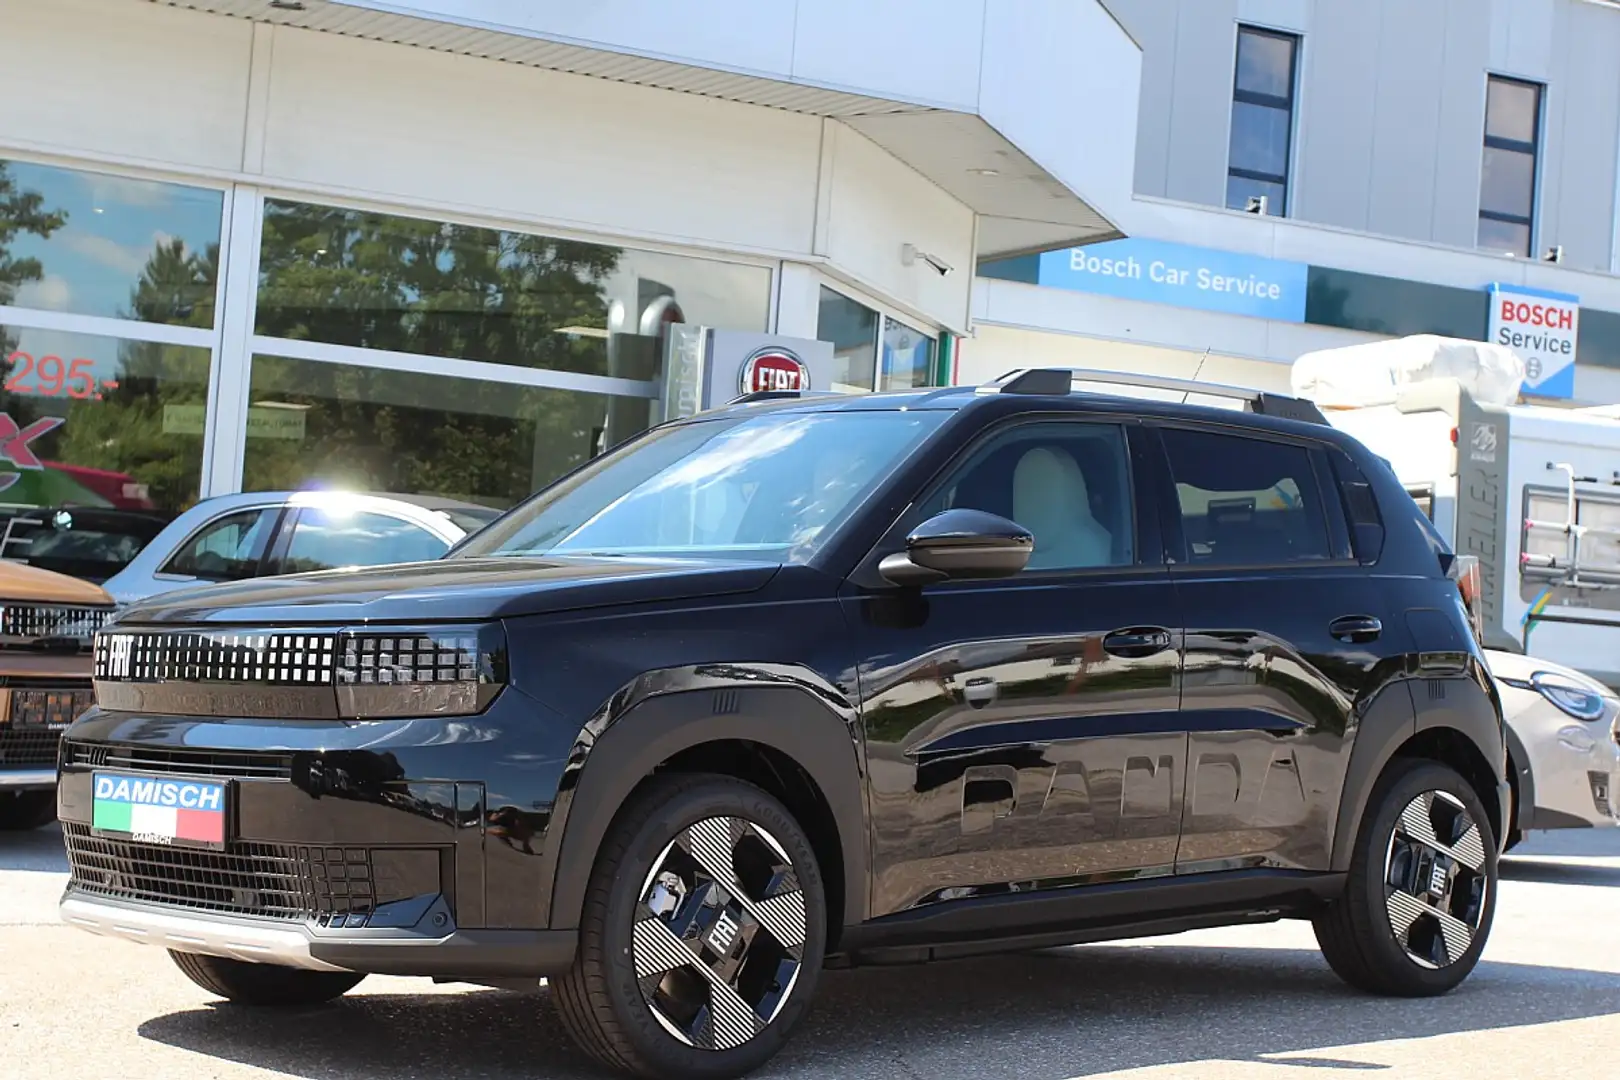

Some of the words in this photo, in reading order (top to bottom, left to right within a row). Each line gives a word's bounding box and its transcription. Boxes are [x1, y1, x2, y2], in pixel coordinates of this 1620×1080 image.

[1070, 248, 1140, 280] Bosch
[1149, 261, 1189, 286] Car
[1196, 268, 1280, 300] Service
[1501, 299, 1572, 330] BOSCH
[1499, 326, 1572, 355] Service
[758, 366, 798, 392] FIAT
[108, 634, 134, 677] FIAT
[95, 777, 220, 809] DAMISCH
[132, 831, 172, 844] DAMISCH
[1431, 862, 1446, 895] FIAT
[708, 910, 739, 954] FIAT
